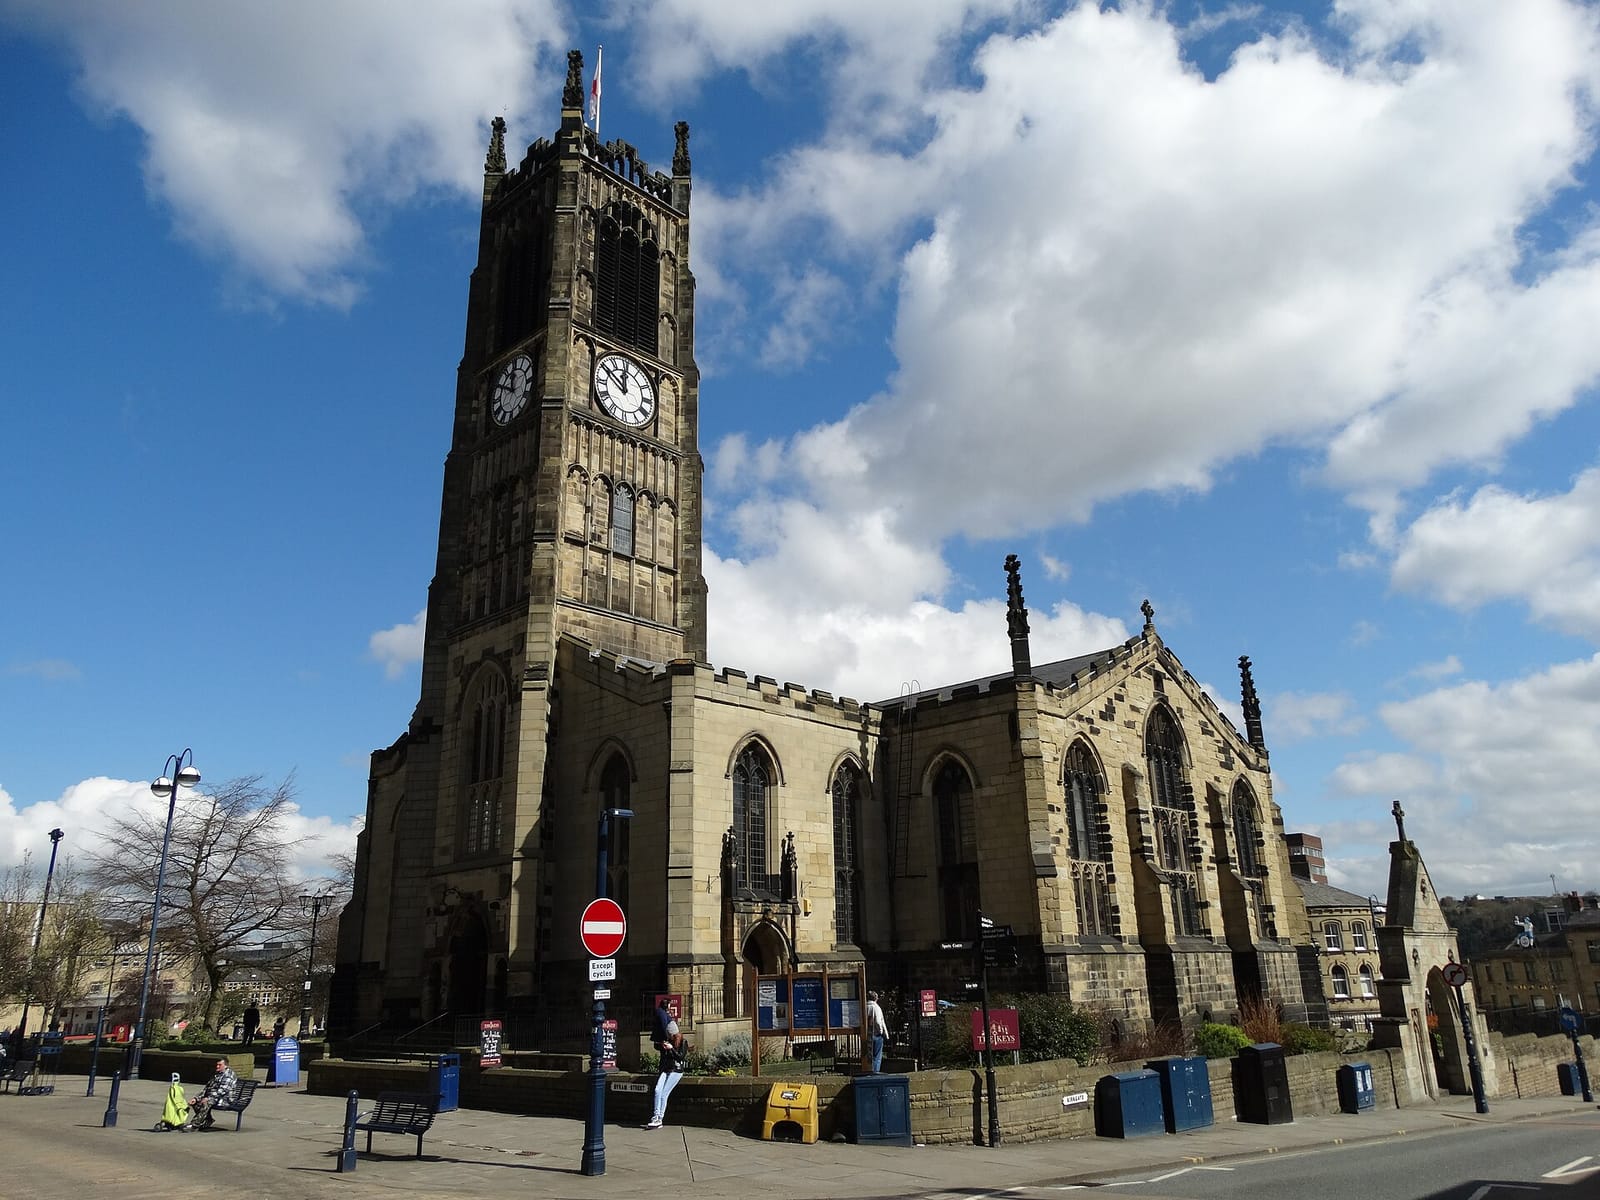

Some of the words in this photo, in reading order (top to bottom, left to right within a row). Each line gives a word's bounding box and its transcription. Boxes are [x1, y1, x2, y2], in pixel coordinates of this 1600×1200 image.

[592, 962, 613, 970] Except
[592, 970, 612, 979] cycles
[996, 1034, 1016, 1043] KEYS
